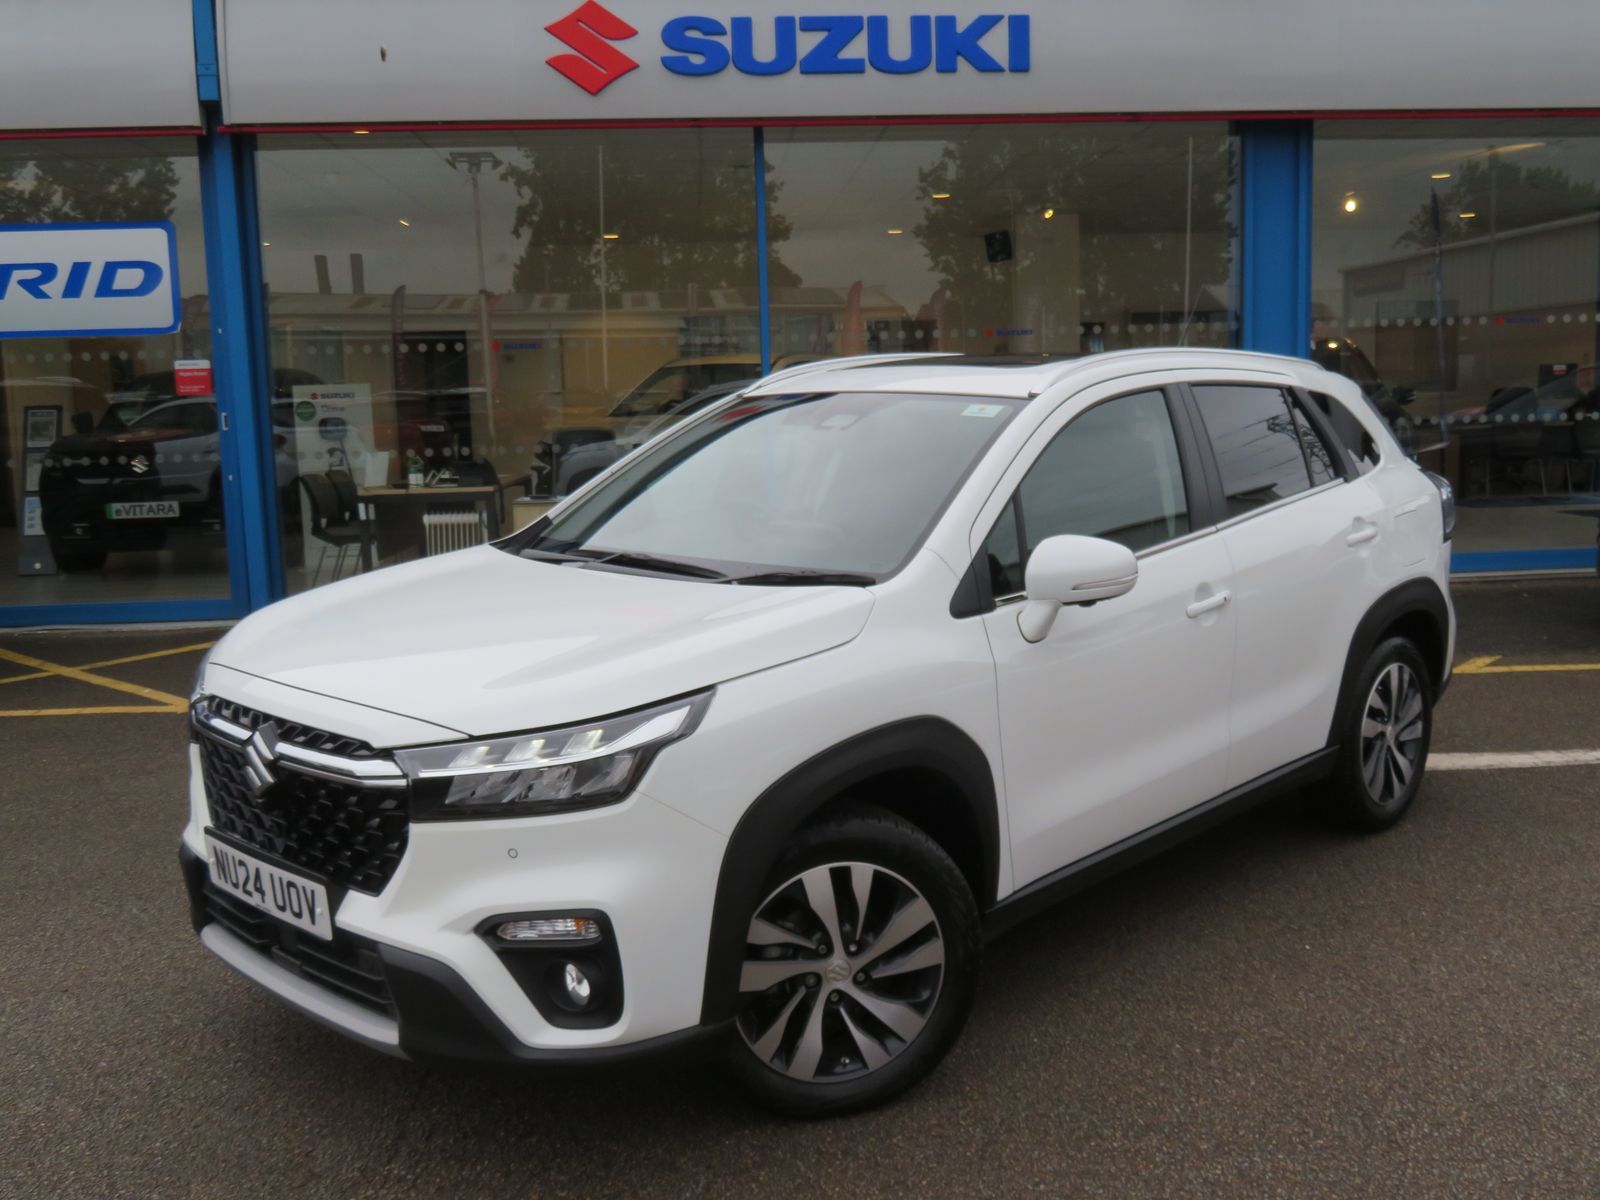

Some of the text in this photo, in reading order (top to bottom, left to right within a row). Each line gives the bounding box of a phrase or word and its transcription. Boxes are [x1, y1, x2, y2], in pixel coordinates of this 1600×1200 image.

[661, 15, 1030, 76] SUZUKI
[0, 261, 164, 300] RID
[115, 503, 177, 516] eVITARA
[213, 845, 316, 926] NU24 UOV
